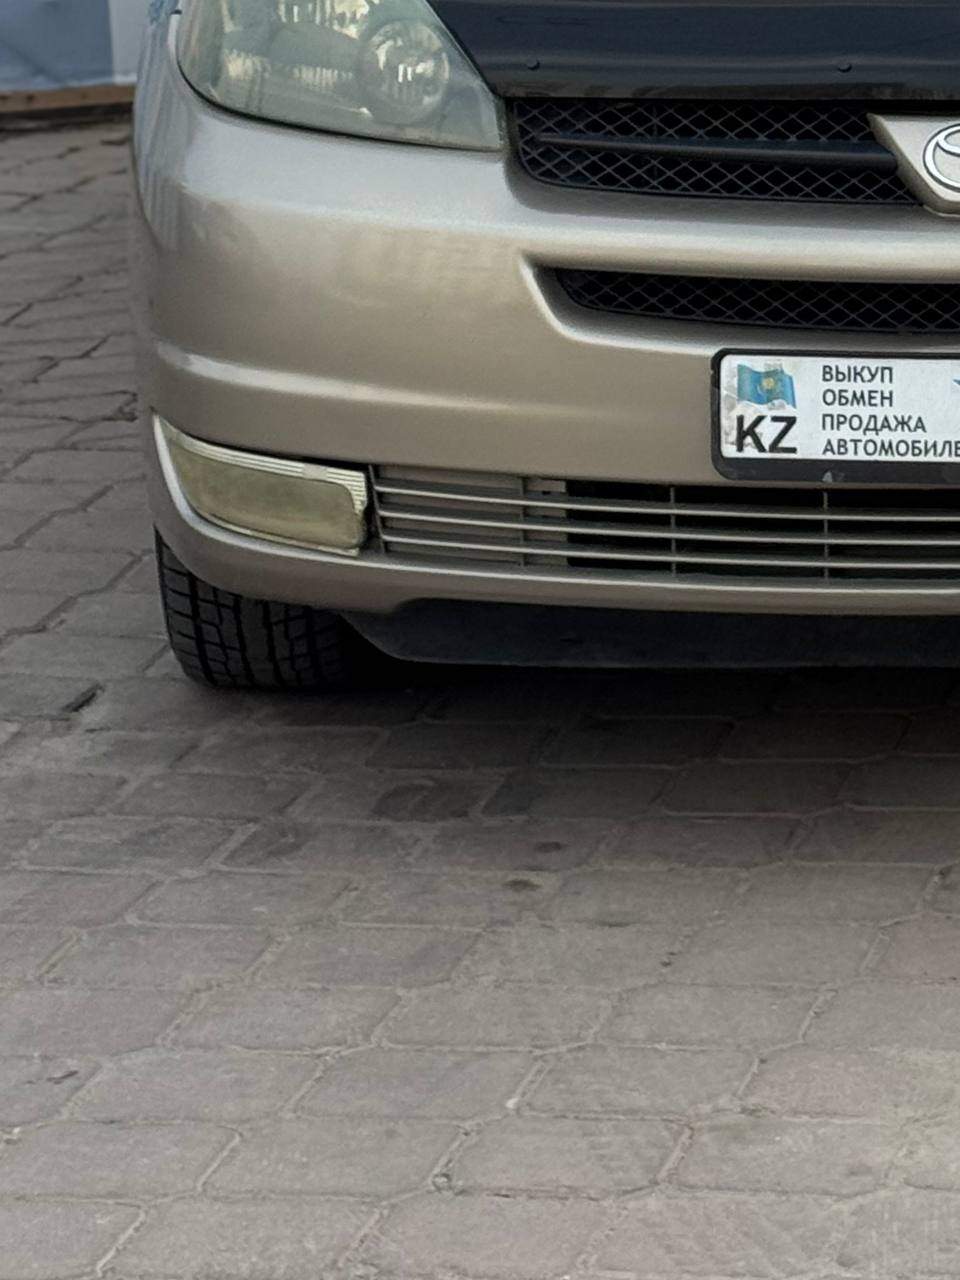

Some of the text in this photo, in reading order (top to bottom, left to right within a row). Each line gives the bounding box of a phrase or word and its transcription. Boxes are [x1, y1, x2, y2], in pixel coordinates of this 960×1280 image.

[822, 365, 893, 384] ВЫКУП
[822, 389, 893, 407] ОБМЕН
[736, 415, 797, 454] KZ
[822, 413, 927, 436] ПРОДАЖА
